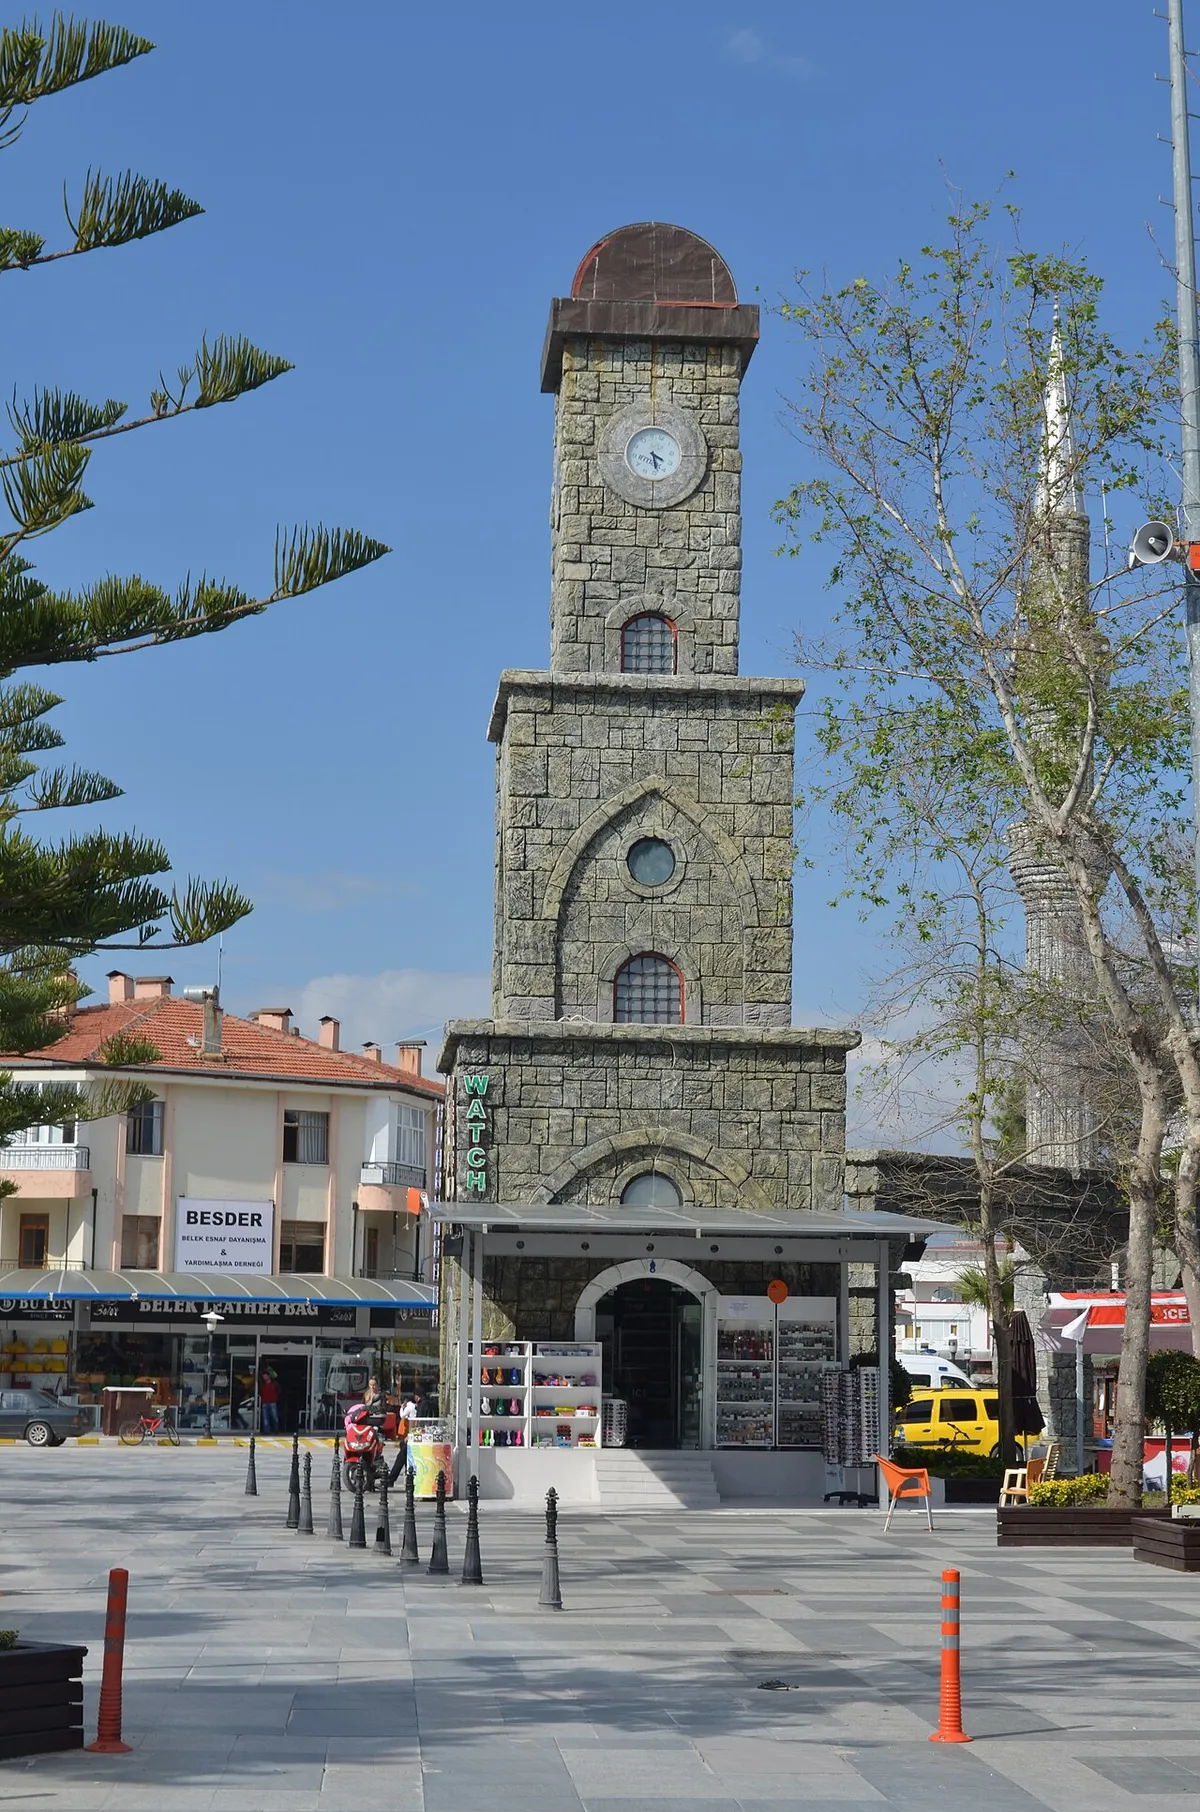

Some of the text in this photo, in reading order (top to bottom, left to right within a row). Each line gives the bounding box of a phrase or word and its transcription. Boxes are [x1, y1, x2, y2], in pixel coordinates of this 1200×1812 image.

[463, 1075, 489, 1191] WATCH
[186, 1210, 262, 1227] BESDER
[228, 1236, 266, 1244] DAYANIŞMA
[220, 1248, 227, 1256] &
[139, 1300, 319, 1316] BELEK LEATHER BAG
[1163, 1309, 1187, 1319] ICE
